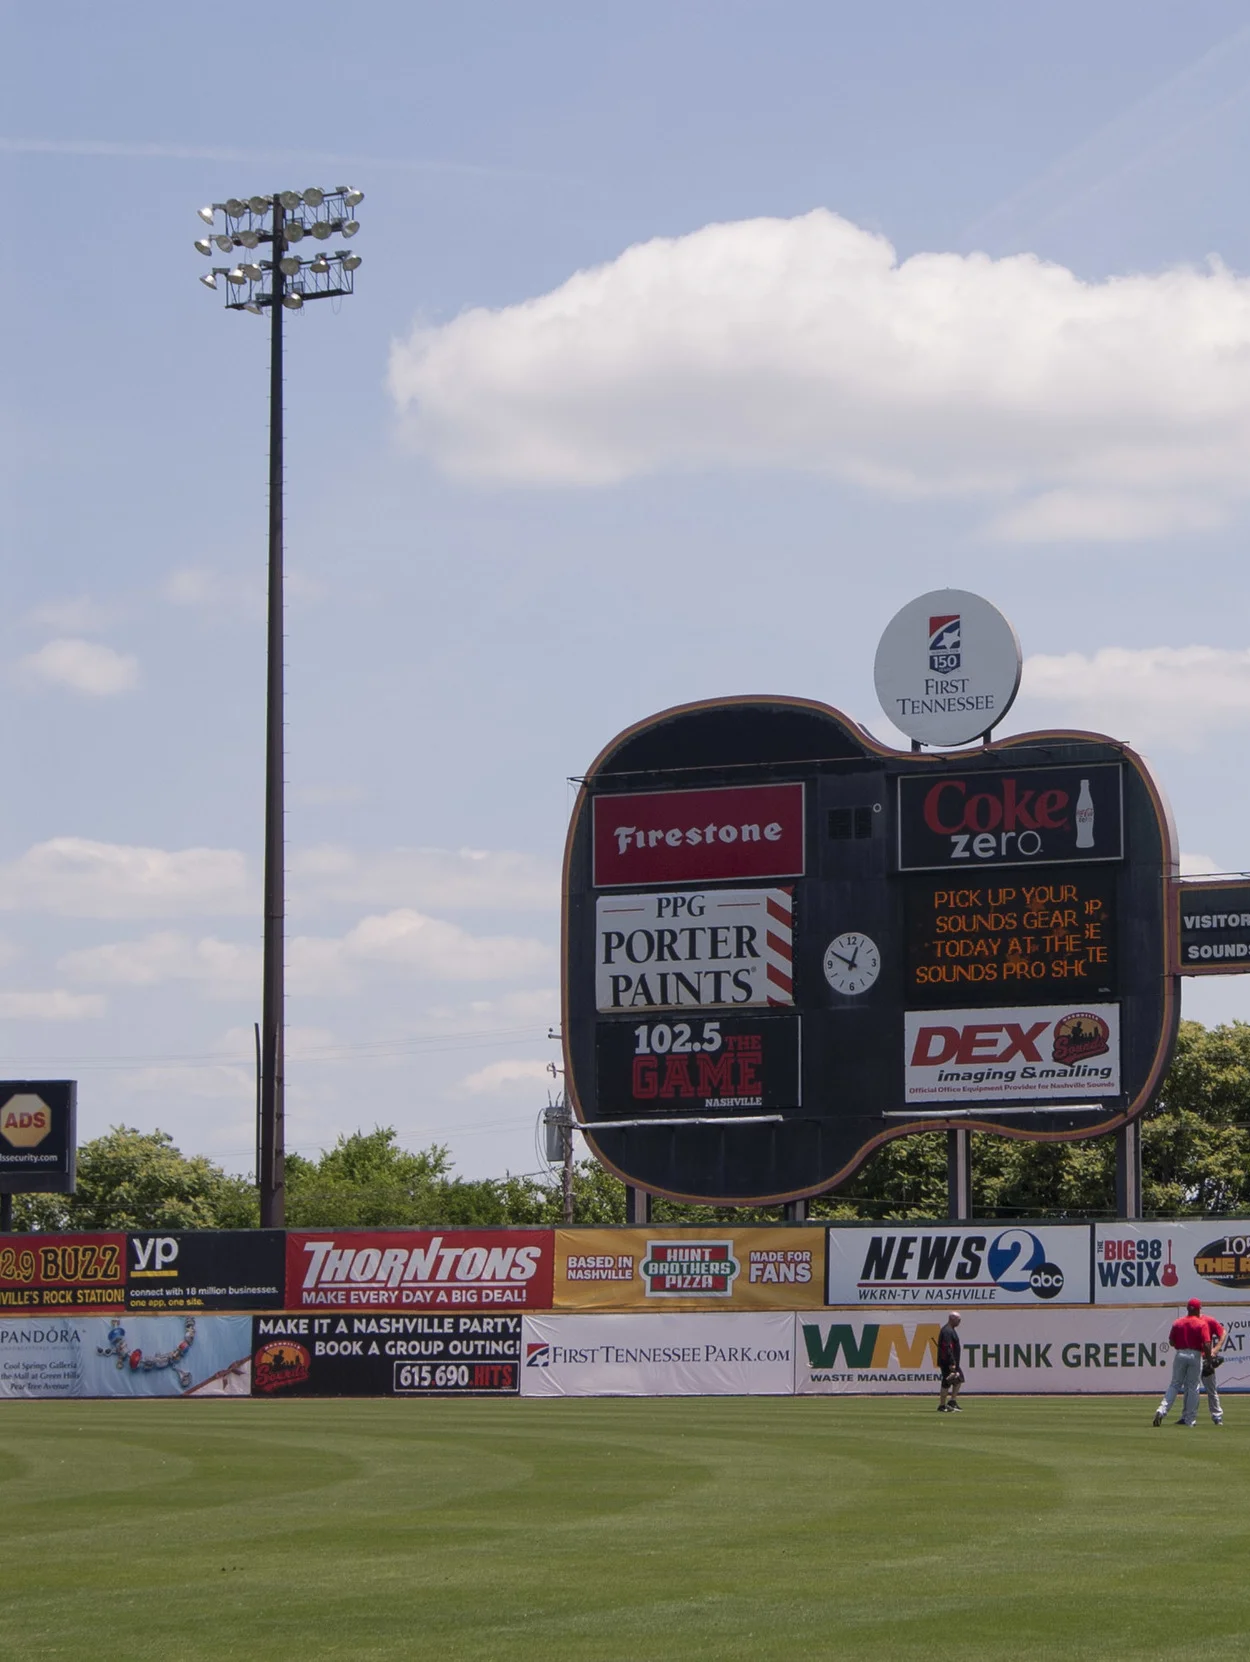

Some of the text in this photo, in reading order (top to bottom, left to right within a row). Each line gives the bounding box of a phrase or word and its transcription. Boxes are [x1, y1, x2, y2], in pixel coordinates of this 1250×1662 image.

[933, 655, 957, 668] 150
[924, 678, 970, 695] FIRST
[896, 695, 994, 715] TENNESSEE
[923, 778, 1070, 834] Coke
[613, 822, 783, 855] Firestone
[950, 831, 1042, 858] zero
[934, 884, 1079, 909] PICK UP YOUR
[656, 894, 706, 918] PPG
[936, 909, 1079, 933] SOUNDS GEAR
[602, 925, 761, 964] PORTER
[932, 934, 1082, 958] TODAY AT THE
[916, 963, 998, 983] SOUNDS
[1003, 960, 1045, 980] PRO
[609, 968, 753, 1007] PAINTS
[634, 1022, 762, 1055] 102.5 THE
[910, 1022, 1052, 1067] DEX
[632, 1052, 763, 1099] GAME
[937, 1068, 1017, 1083] imaging
[962, 1085, 1003, 1093] Equipment
[1004, 1083, 1037, 1091] Provider
[705, 1097, 763, 1107] NASHVILLE
[4, 1111, 46, 1128] ADS
[132, 1237, 179, 1270] yp
[567, 1255, 634, 1269] BASED IN
[666, 1248, 713, 1262] HUNT
[750, 1251, 811, 1262] MADE FOR
[860, 1229, 1037, 1283] NEWS 2
[39, 1244, 120, 1281] BUZZ
[648, 1262, 731, 1275] BROTHERS
[1194, 1257, 1236, 1274] THE
[567, 1268, 633, 1280] NASHVILLE
[665, 1274, 713, 1289] PIZZA
[750, 1263, 812, 1283] FANS
[1030, 1271, 1063, 1288] abc
[1097, 1261, 1162, 1288] WSIX
[43, 1290, 73, 1304] ROCK
[77, 1288, 125, 1303] STATION!
[130, 1285, 279, 1297] connect with 18 million businesses.
[302, 1289, 527, 1304] MAKE EVERY DAY A BIG DEAL!
[858, 1288, 997, 1301] WKRN-TV NASHVILLE
[130, 1299, 146, 1307] one
[258, 1317, 521, 1335] MAKE IT A NASHVILLE PARTY.
[0, 1328, 81, 1343] PANDORA
[315, 1340, 363, 1356] BOOK
[367, 1341, 380, 1356] A
[385, 1340, 444, 1355] GROUP
[448, 1339, 520, 1355] OUTING!
[963, 1342, 1167, 1369] THINK GREEN.
[3, 1361, 77, 1371] Cool Springs Galleria
[63, 1371, 80, 1379] Hills
[400, 1365, 513, 1387] 615.690.HITS
[810, 1373, 944, 1382] WASTE MANAGEMEN
